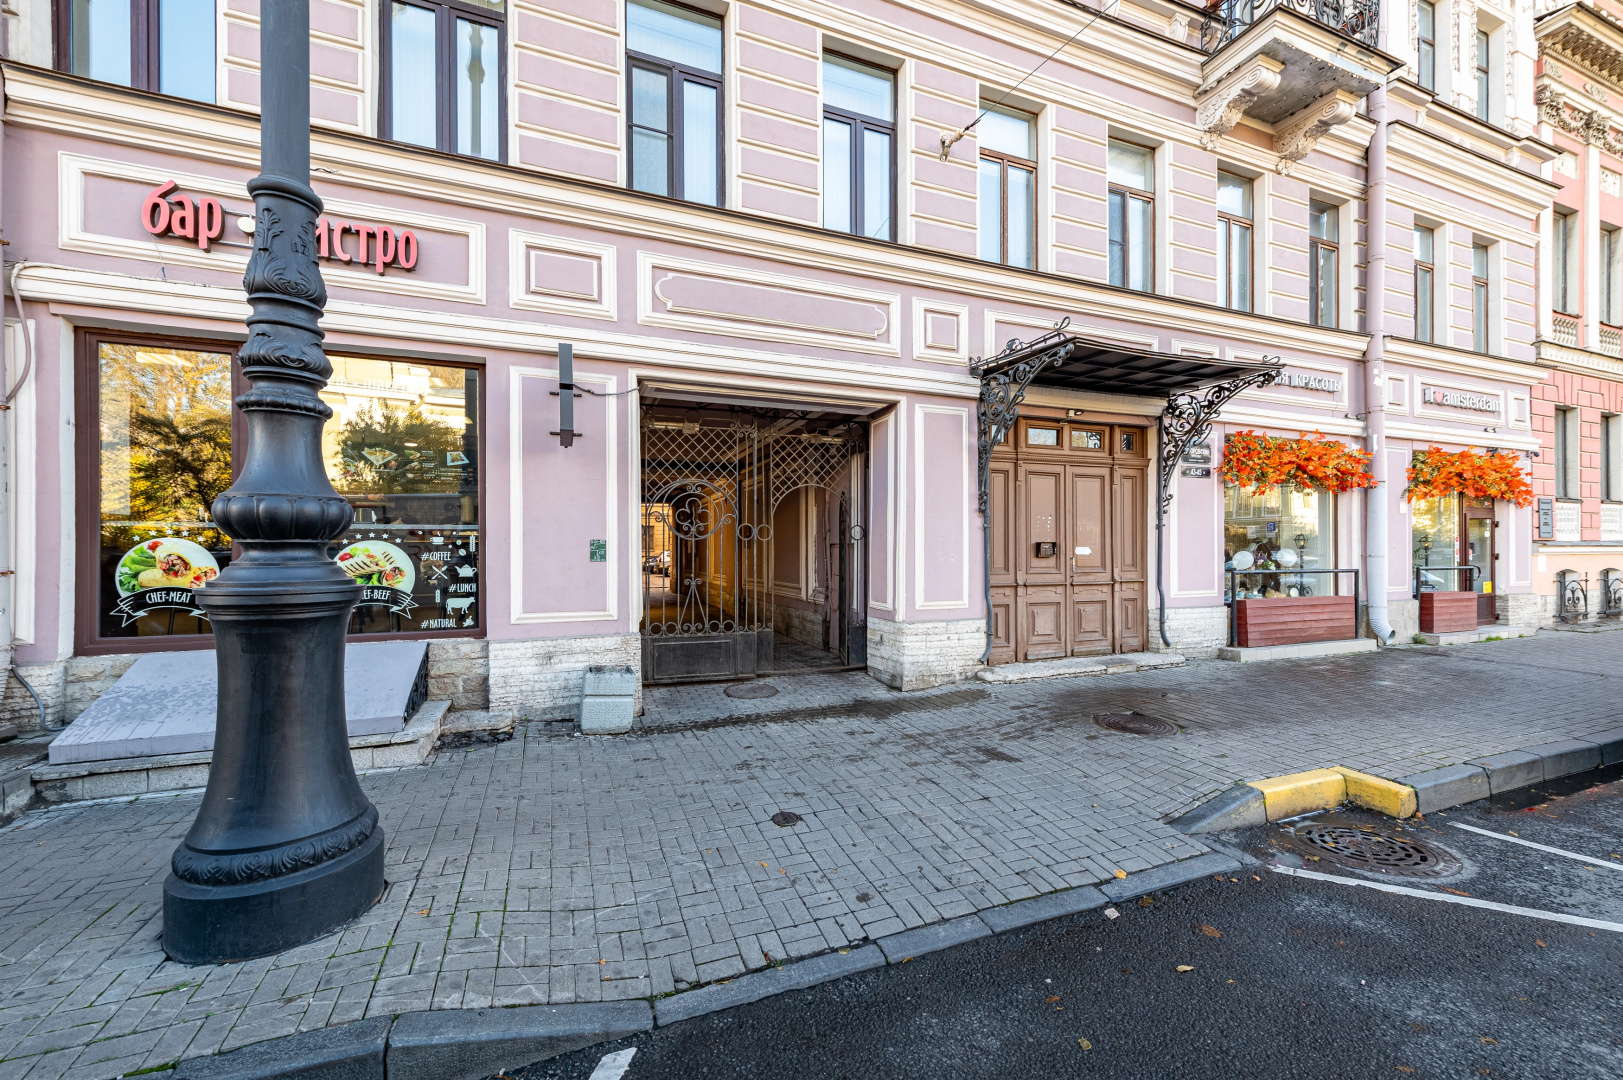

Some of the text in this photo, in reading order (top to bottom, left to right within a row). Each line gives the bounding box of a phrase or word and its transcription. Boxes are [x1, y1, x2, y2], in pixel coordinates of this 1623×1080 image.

[142, 179, 418, 274] бар истро
[1296, 374, 1341, 392] КРАСОТЫ
[1443, 392, 1500, 411] amsterdam
[421, 551, 452, 561] #COFFEE
[448, 583, 477, 593] #LUNCH
[145, 591, 192, 604] CHEF-MEAT
[420, 618, 457, 629] #NATURAL
